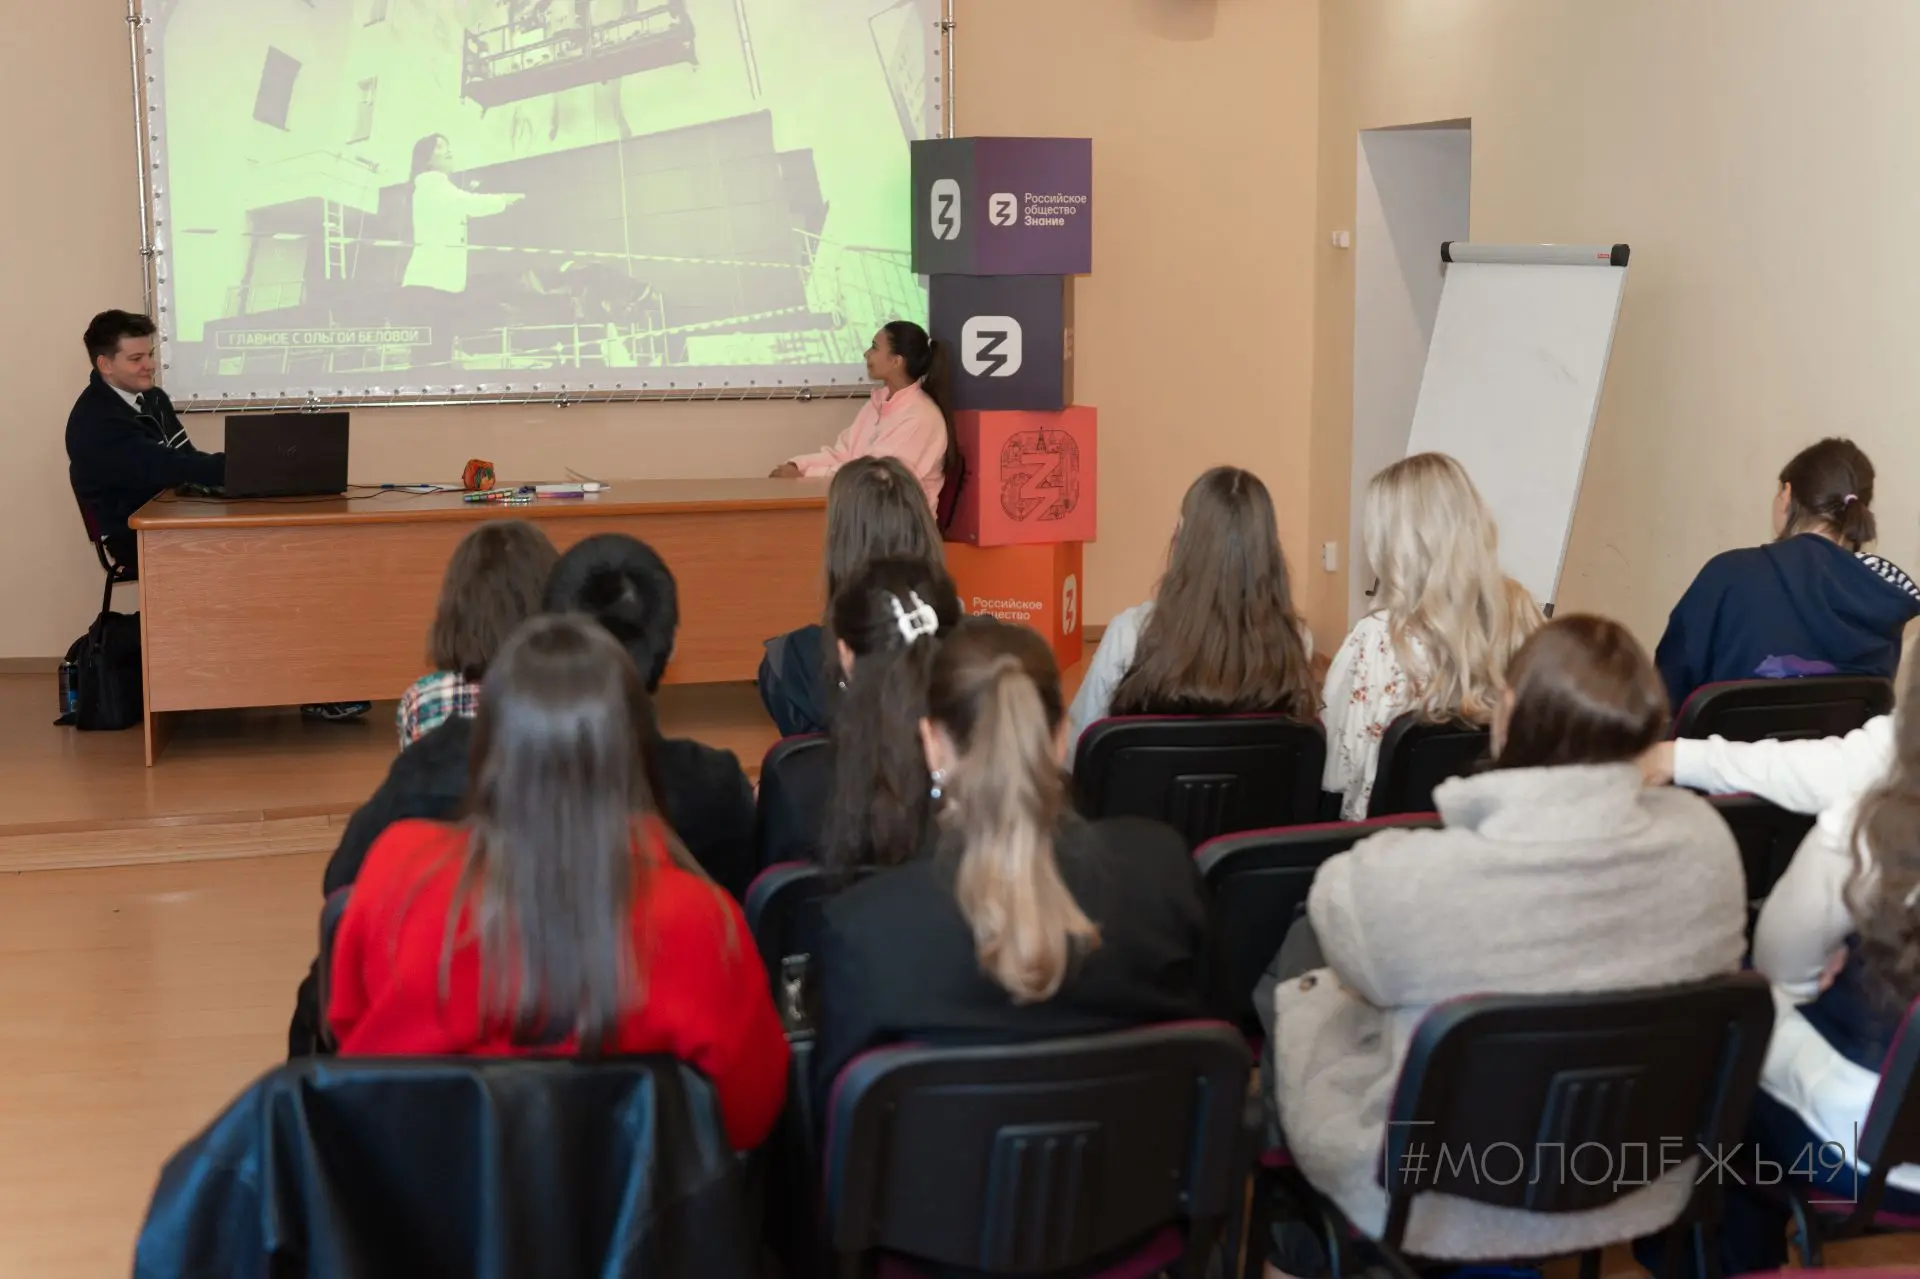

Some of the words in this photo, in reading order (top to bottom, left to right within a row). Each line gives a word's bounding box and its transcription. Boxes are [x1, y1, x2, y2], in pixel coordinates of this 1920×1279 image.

[1024, 193, 1087, 204] Российское
[1024, 204, 1076, 217] общество
[1024, 216, 1065, 226] Знание
[229, 332, 288, 346] ГЛАВНОЕ
[304, 329, 356, 344] ОЛЬГОЙ
[358, 329, 418, 343] БЕЛОВОЙ
[973, 596, 1042, 610] Российское
